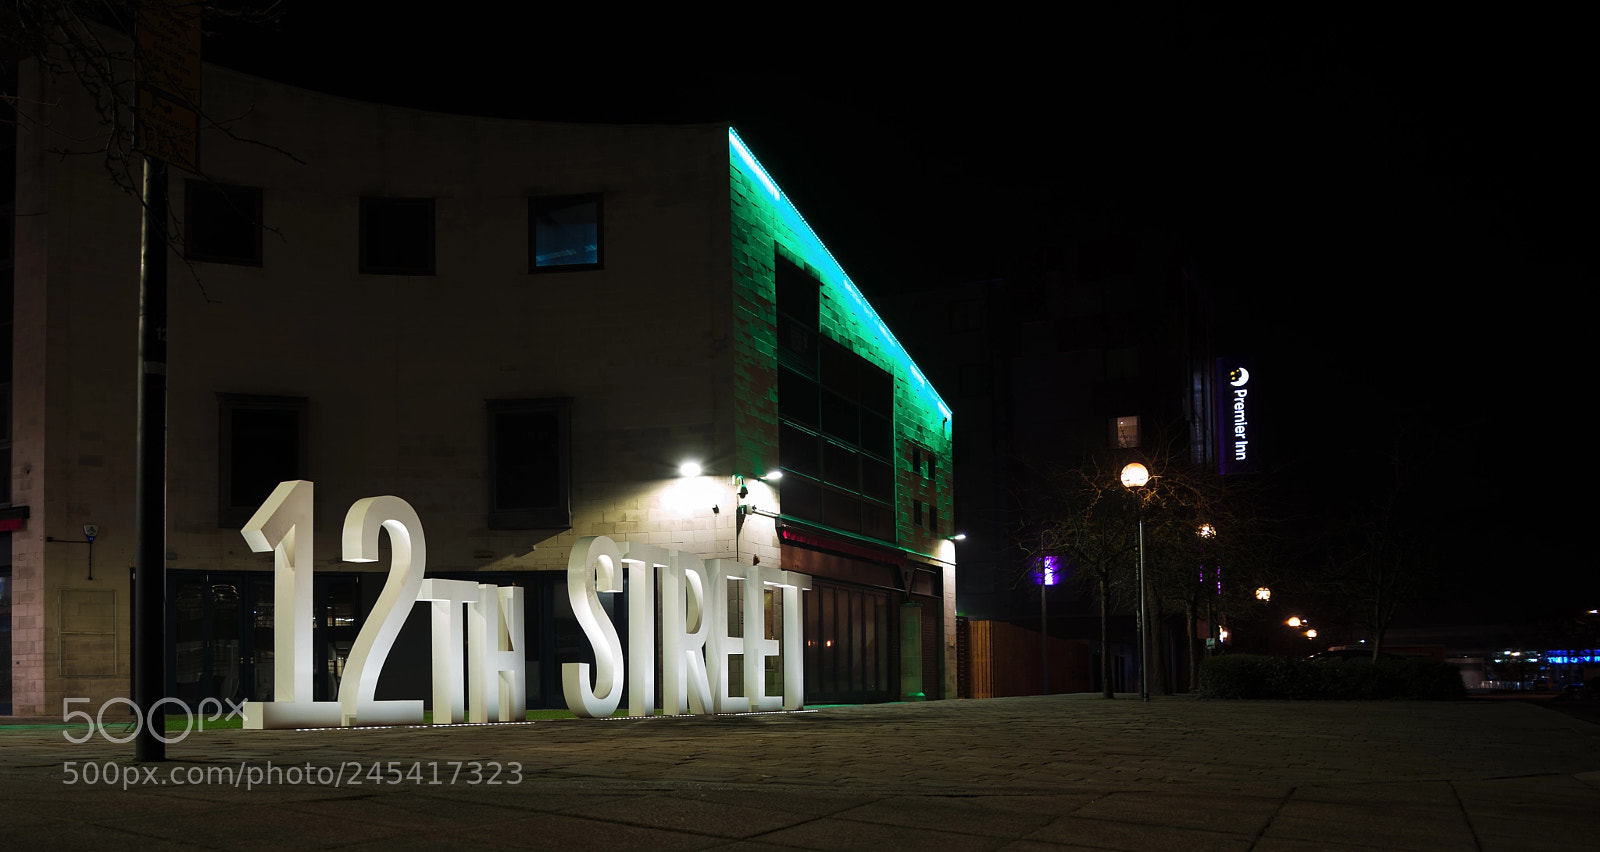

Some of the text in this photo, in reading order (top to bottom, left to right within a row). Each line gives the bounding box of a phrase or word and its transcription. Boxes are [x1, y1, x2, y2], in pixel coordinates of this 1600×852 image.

[1233, 388, 1249, 460] Premier Inn
[562, 535, 813, 718] STREET
